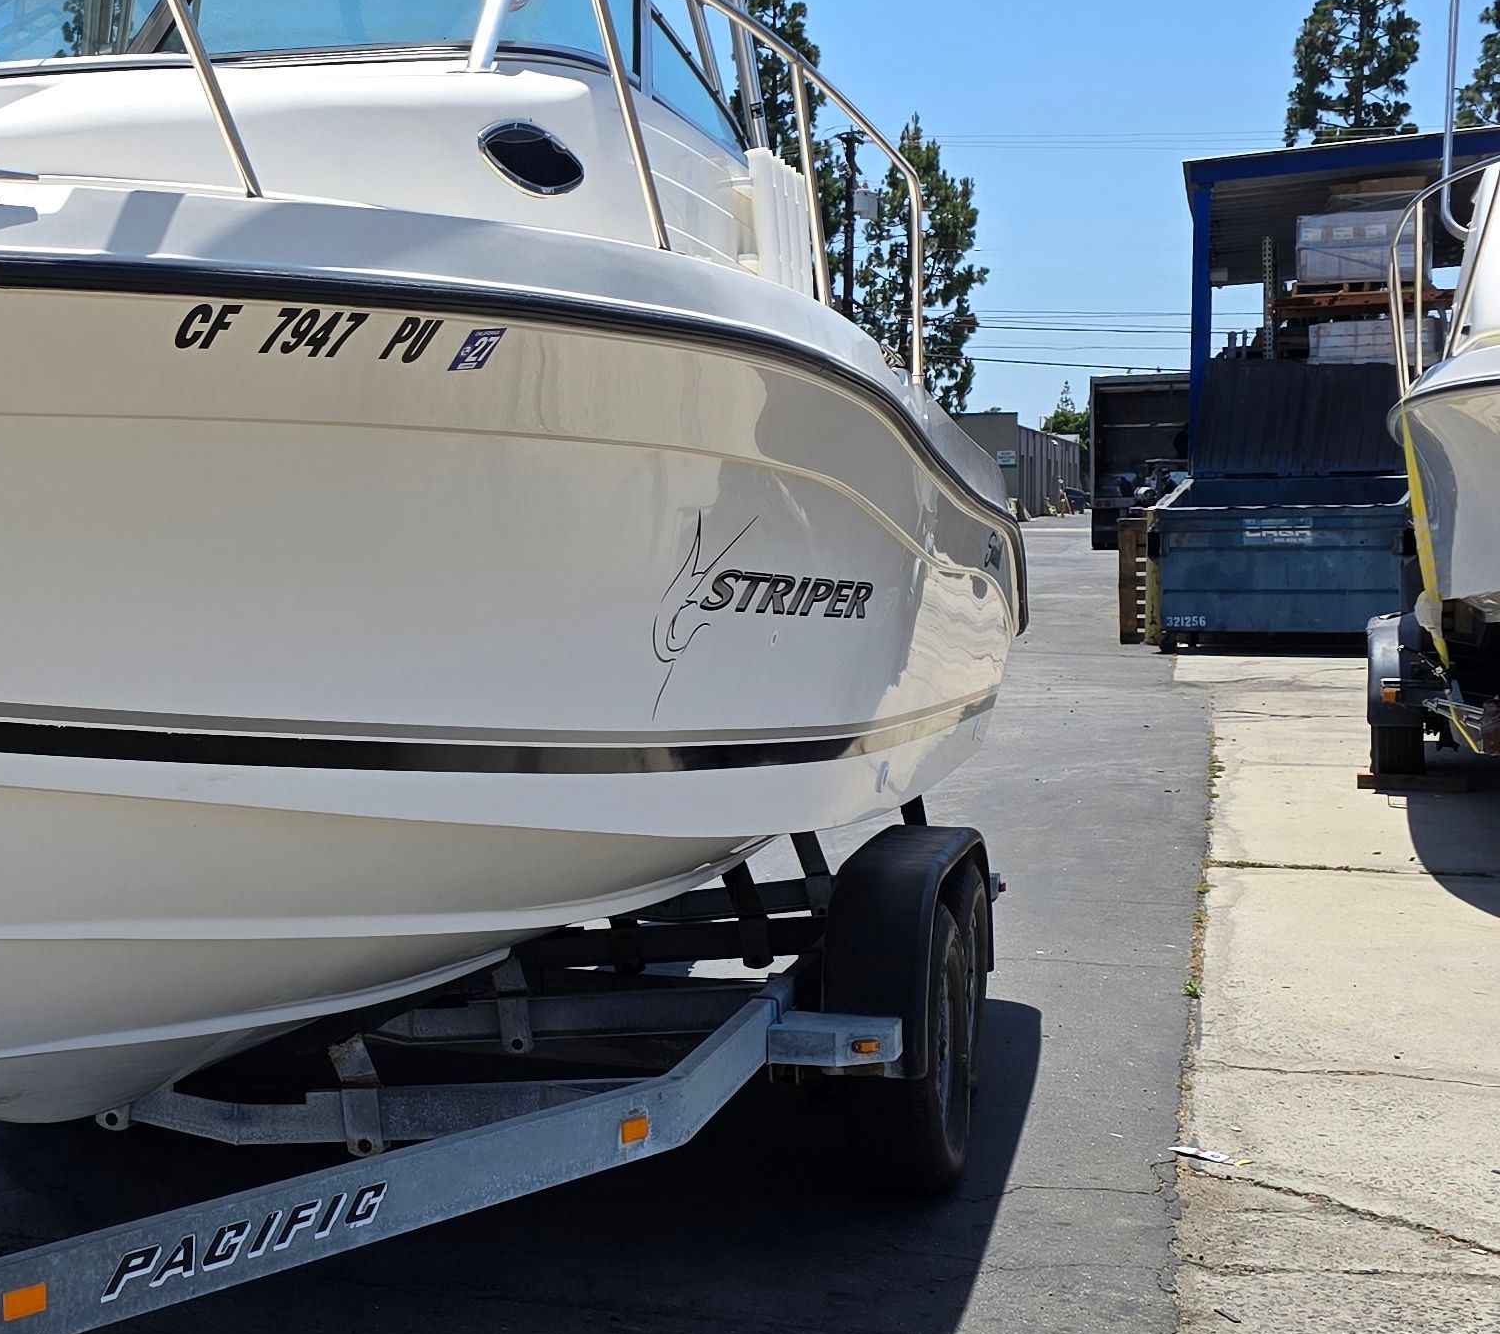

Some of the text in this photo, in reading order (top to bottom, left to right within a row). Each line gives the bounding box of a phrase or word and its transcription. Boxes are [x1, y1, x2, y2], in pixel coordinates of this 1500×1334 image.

[174, 303, 444, 364] CF 7947 PU
[464, 336, 501, 362] 27
[700, 569, 874, 619] STRIPER
[1165, 615, 1206, 627] 321256
[100, 1180, 388, 1303] PACIFIC
